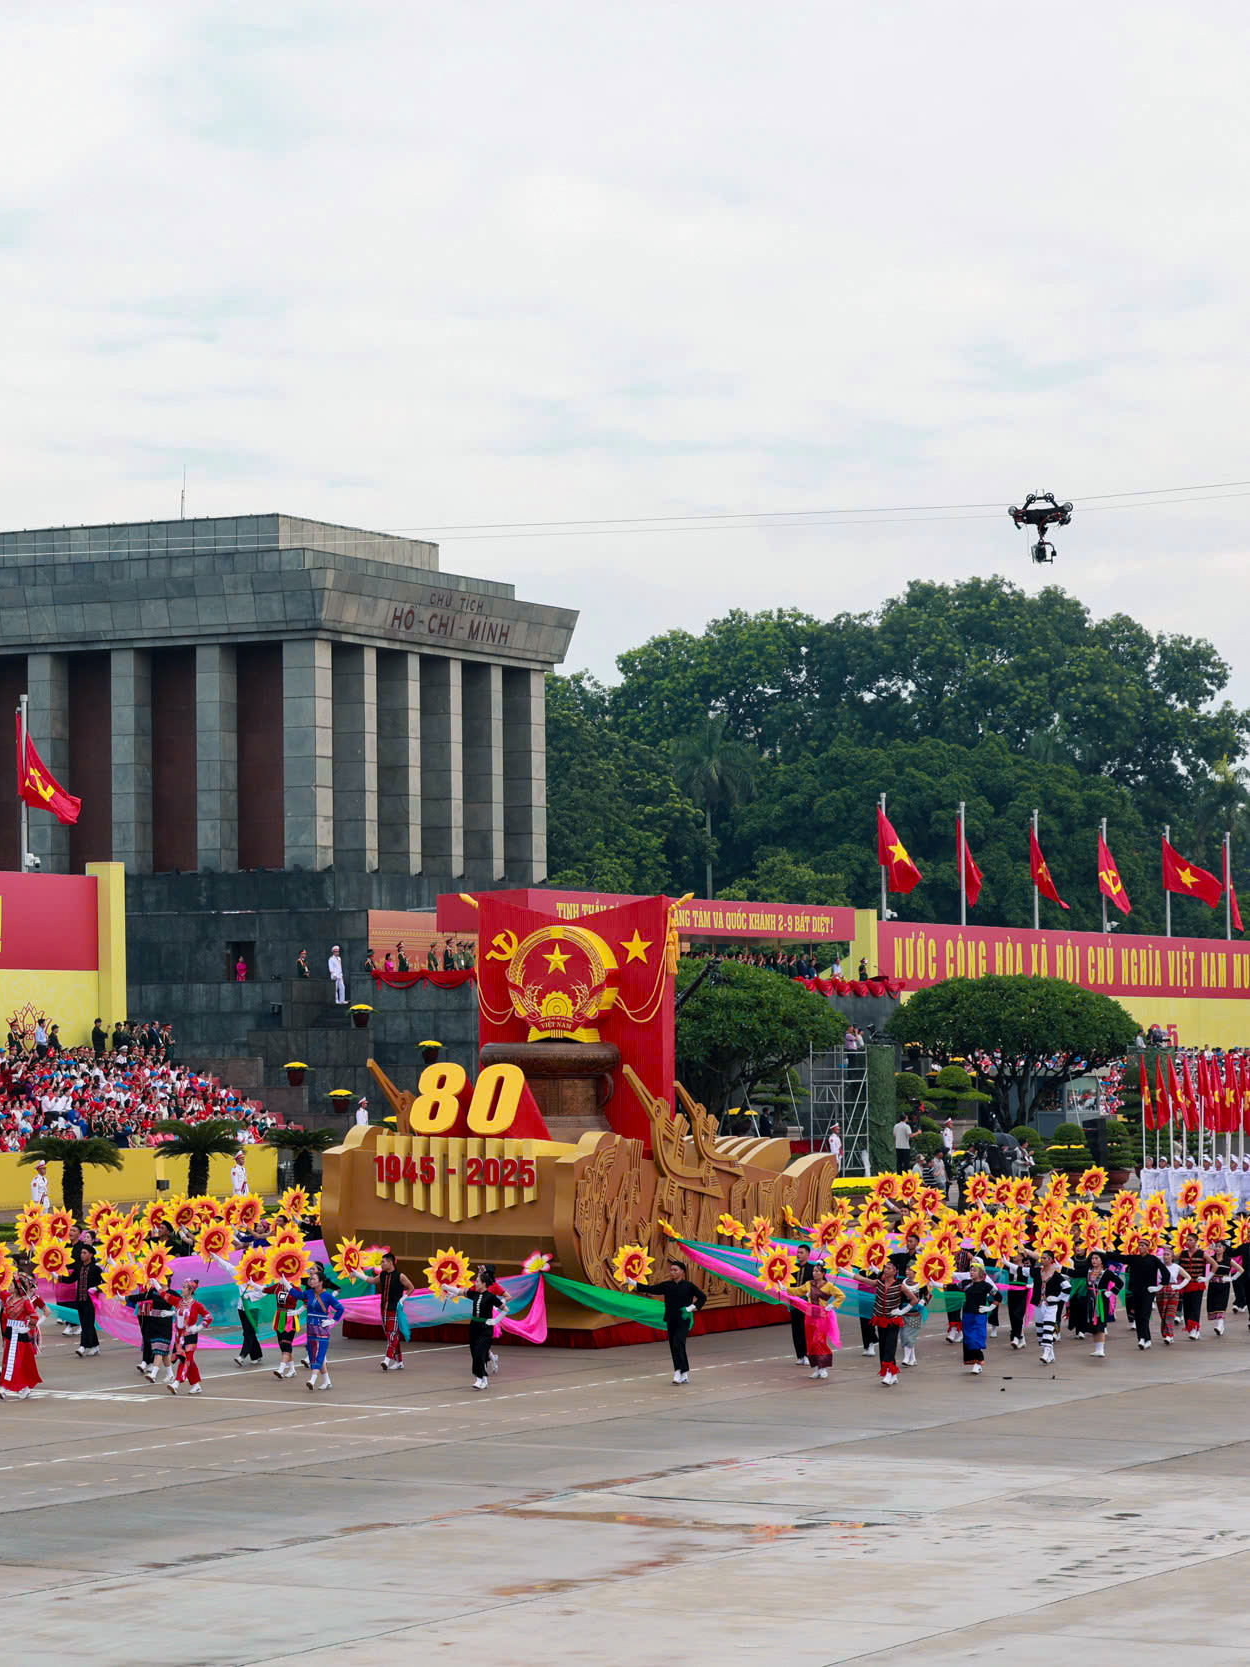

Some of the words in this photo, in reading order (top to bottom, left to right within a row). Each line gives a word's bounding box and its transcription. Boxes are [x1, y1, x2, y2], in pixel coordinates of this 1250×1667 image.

[692, 906, 711, 929] TÁM
[713, 907, 725, 929] VÀ
[726, 907, 747, 930] QUỐC
[749, 910, 777, 931] KHÁNH
[894, 931, 937, 980] NƯỚC
[1088, 937, 1114, 985] CHỦ
[1121, 943, 1162, 986] NGHĨA
[1167, 944, 1195, 994] VIỆT
[1202, 952, 1227, 988] NAM
[410, 1062, 525, 1134] 80
[374, 1155, 435, 1184] 1945
[466, 1158, 536, 1187] 2025
